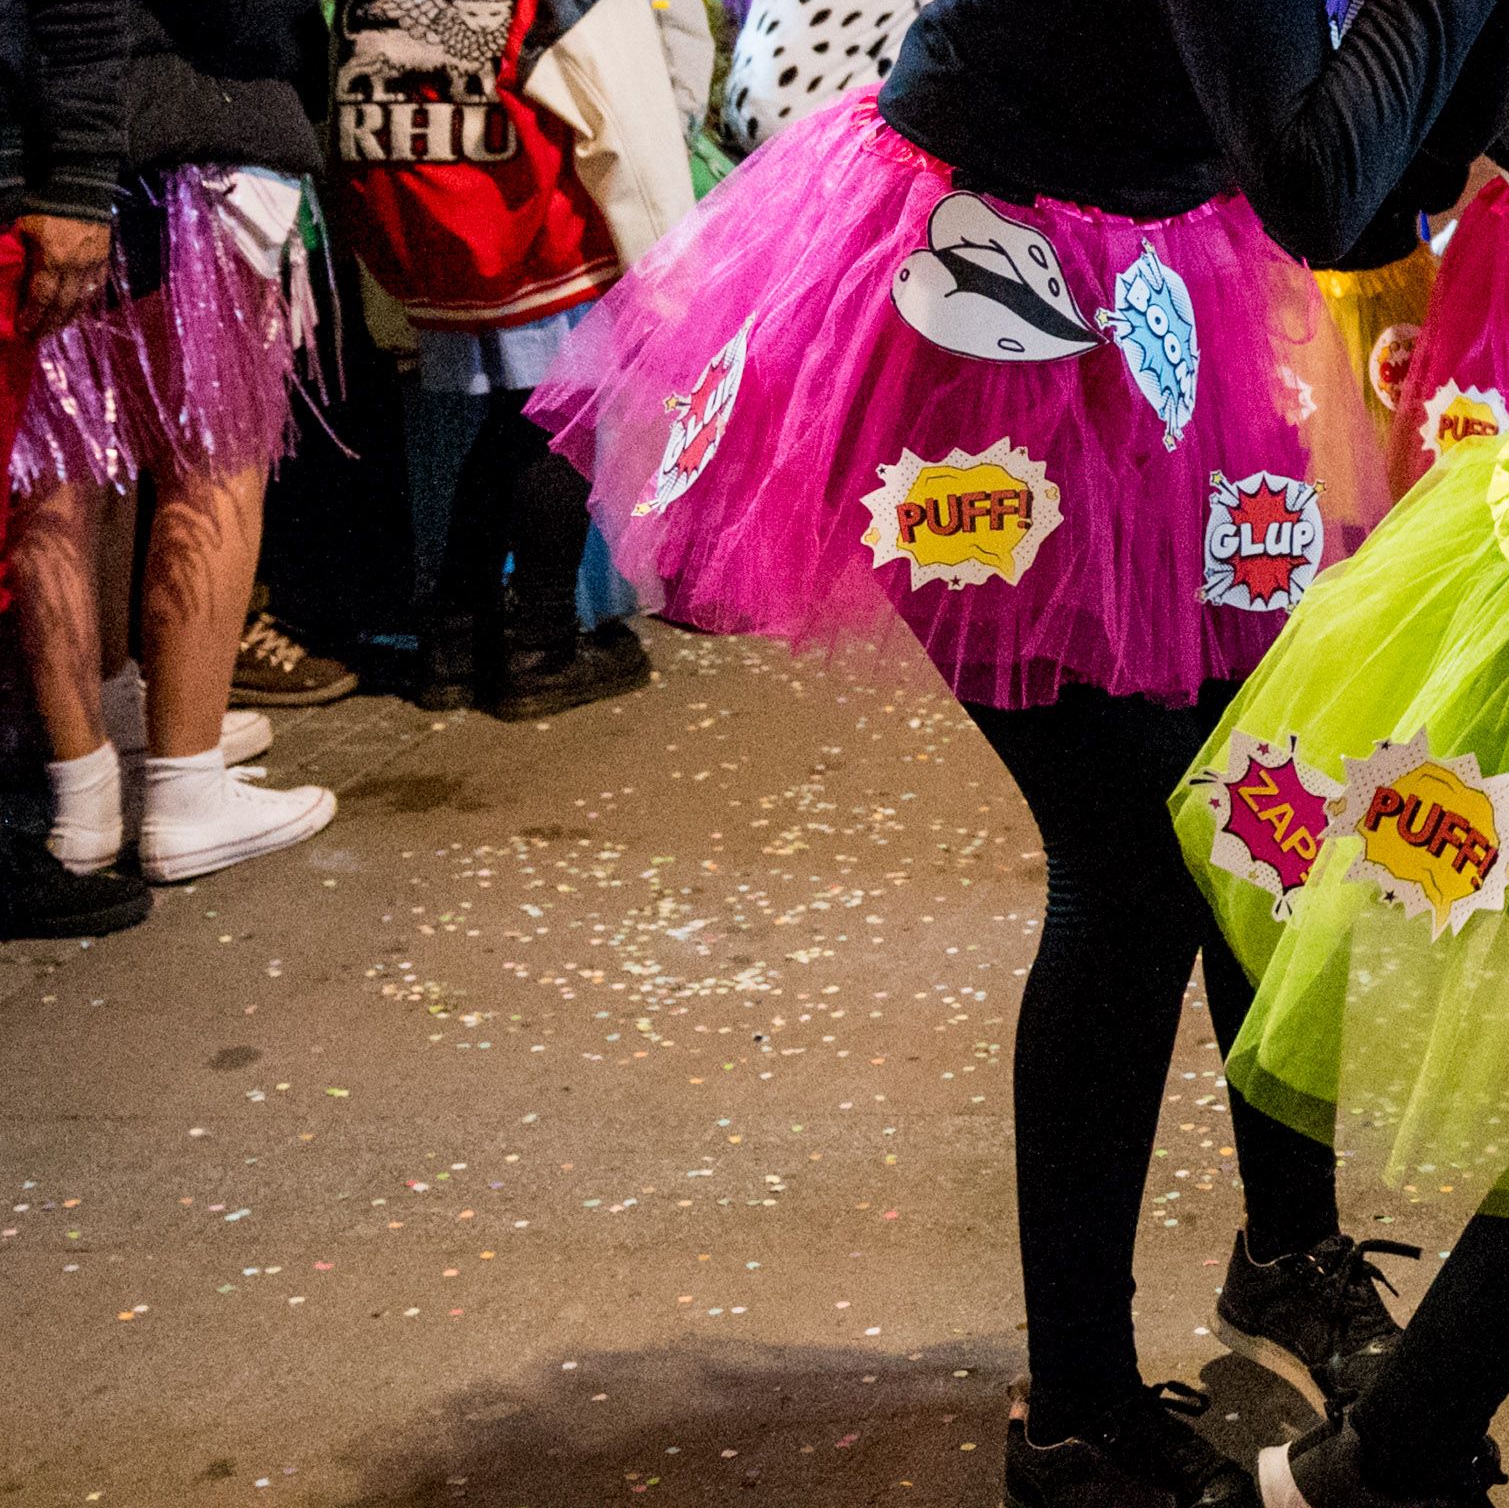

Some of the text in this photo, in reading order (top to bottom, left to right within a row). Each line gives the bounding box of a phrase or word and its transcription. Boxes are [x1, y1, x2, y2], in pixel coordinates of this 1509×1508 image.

[896, 489, 1034, 543] PUFF!
[1210, 520, 1316, 560] GLUP
[1363, 786, 1500, 892] PUFF!
